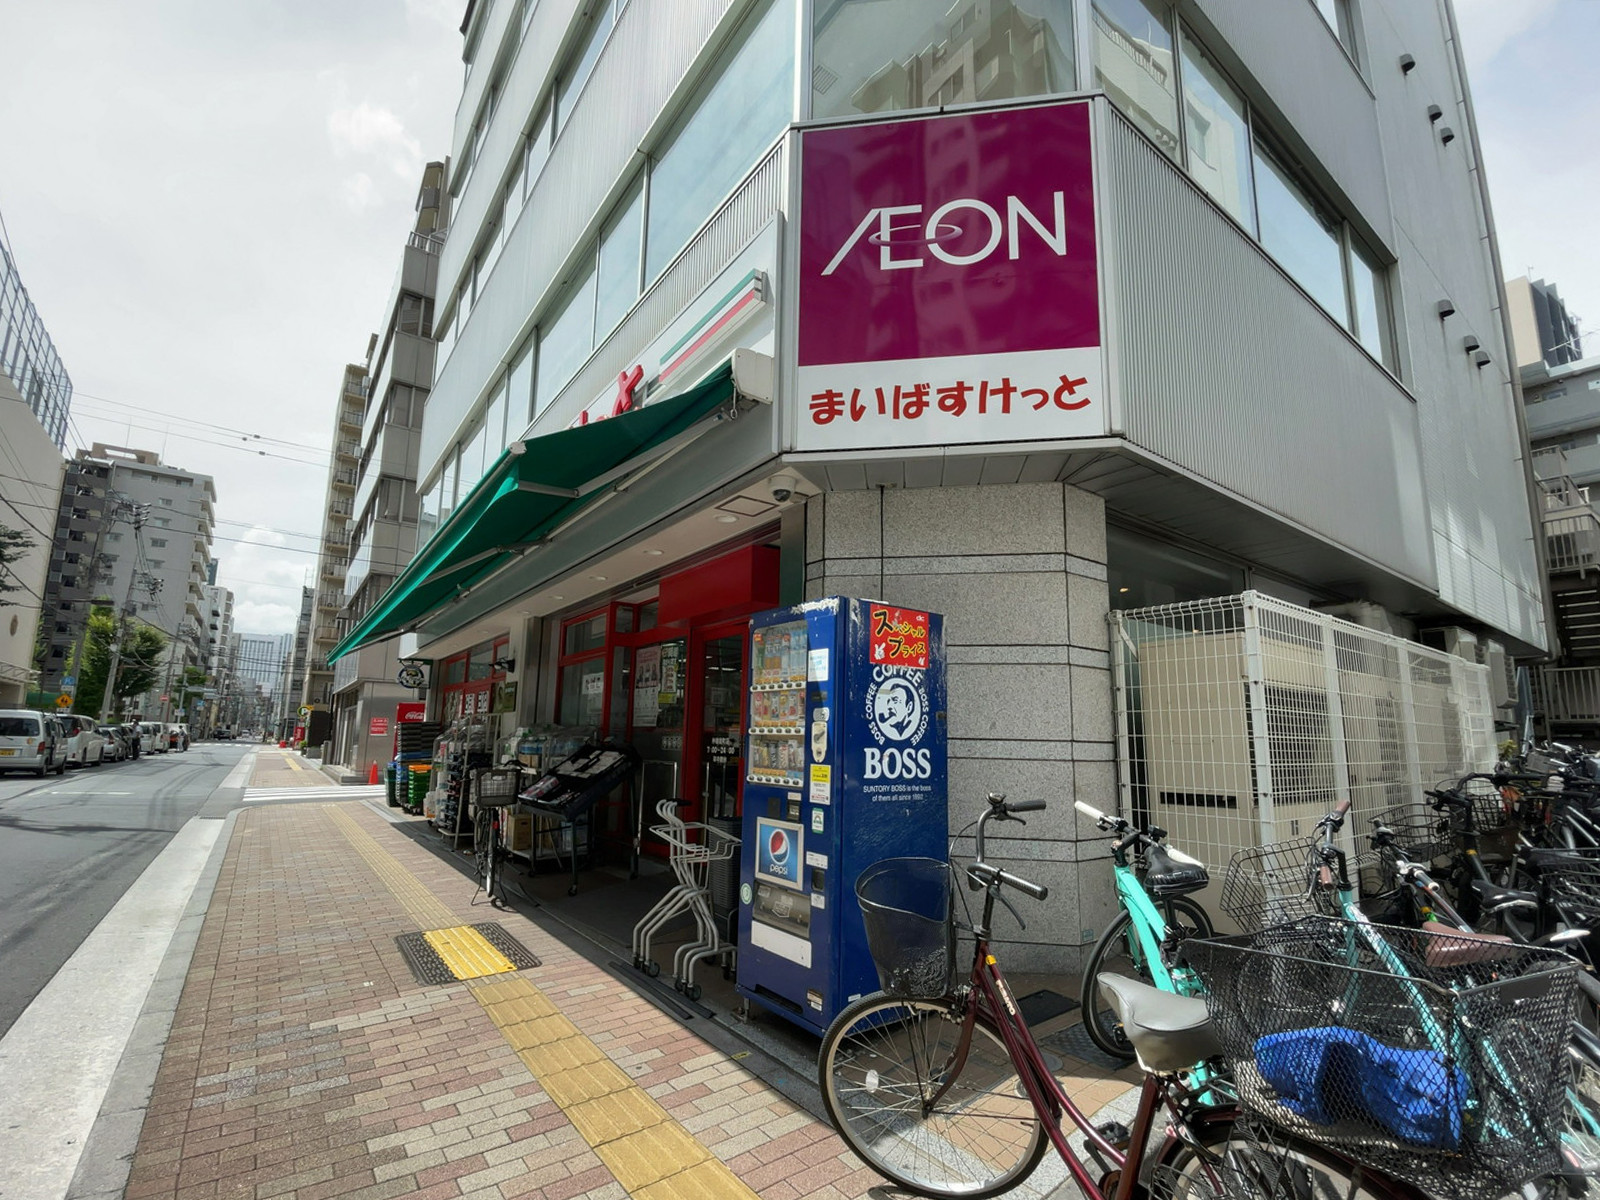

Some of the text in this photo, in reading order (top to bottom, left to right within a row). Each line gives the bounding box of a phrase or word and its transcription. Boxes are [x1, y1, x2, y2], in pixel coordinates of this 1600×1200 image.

[809, 374, 1091, 426] まいばすけっと
[888, 636, 926, 658] プライス
[873, 664, 923, 686] COFFEE
[865, 682, 885, 745] BOSS COFFEE
[910, 687, 929, 746] BOSS COFFEE
[863, 747, 931, 779] BOSS
[863, 785, 890, 793] SUNTORY
[891, 784, 906, 792] BOSS
[878, 794, 891, 802] them
[769, 863, 788, 875] pepsi
